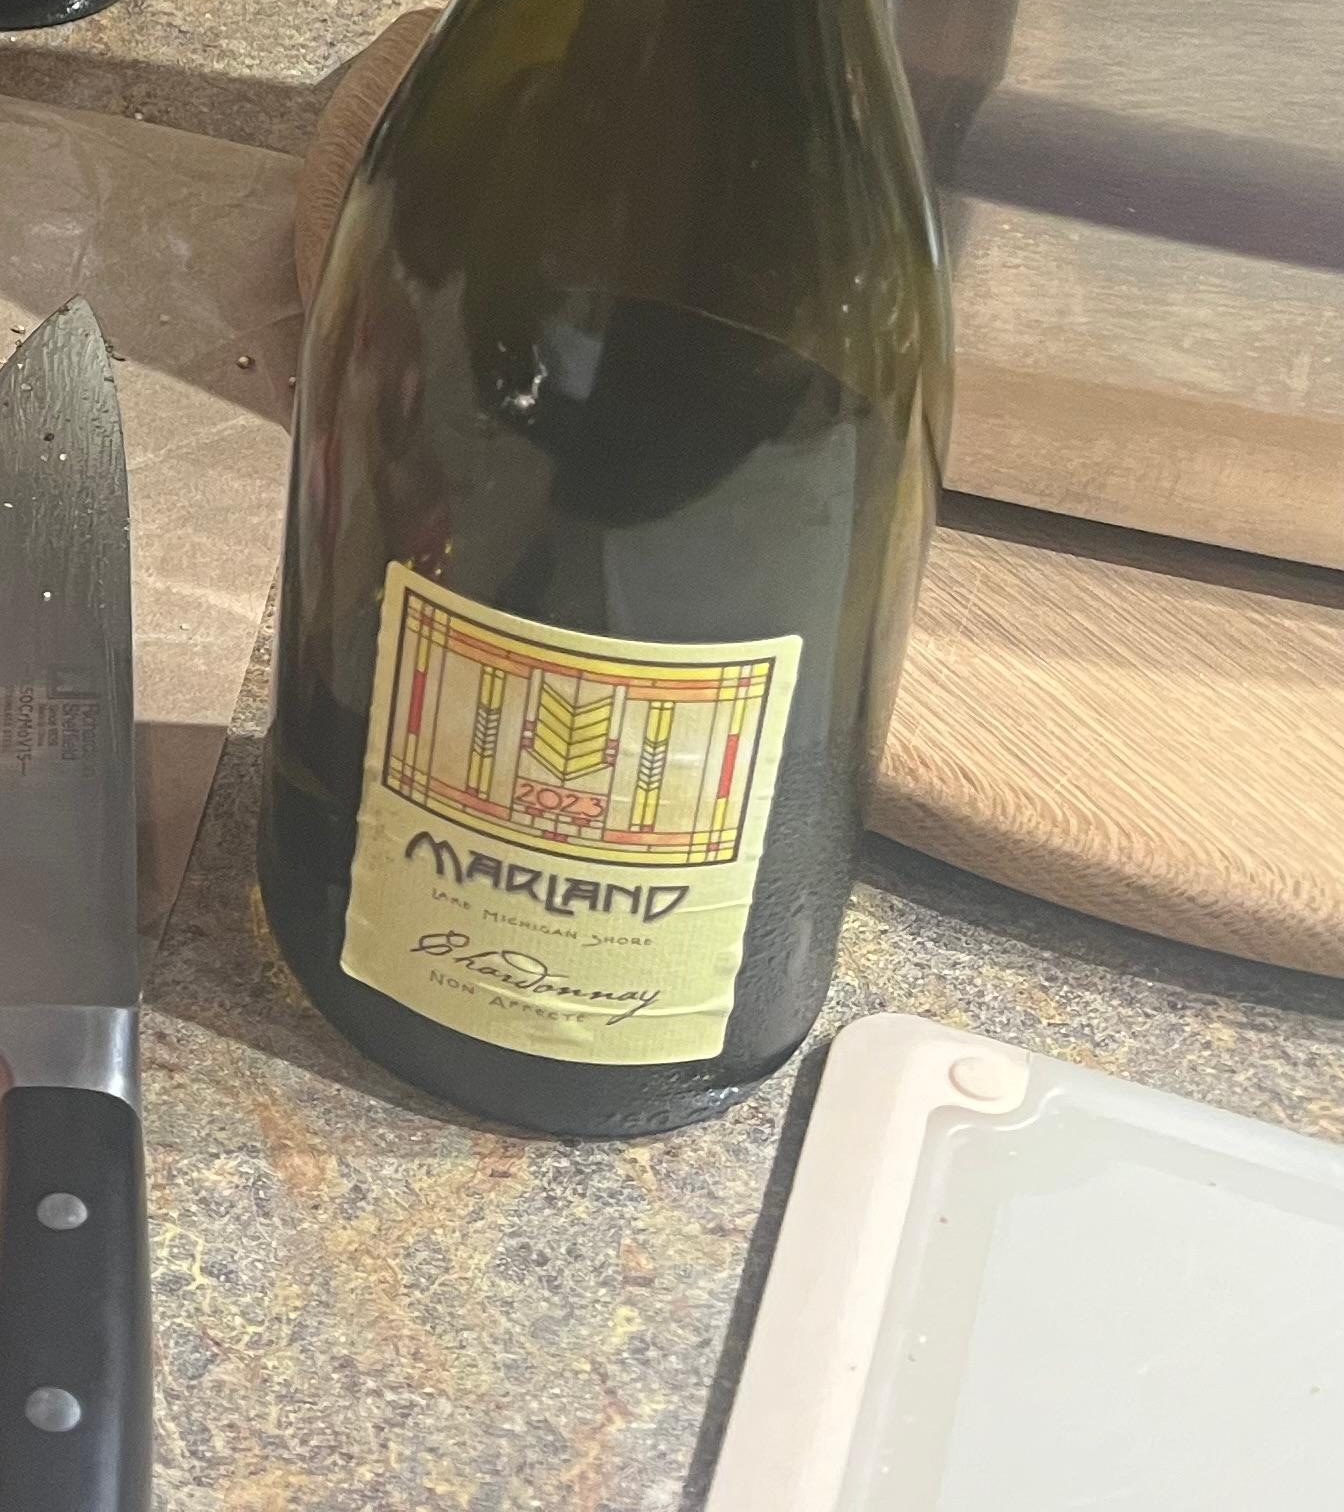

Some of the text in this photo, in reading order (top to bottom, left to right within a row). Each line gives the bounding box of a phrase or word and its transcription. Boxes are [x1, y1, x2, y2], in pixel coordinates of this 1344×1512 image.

[514, 783, 607, 818] 2023
[404, 830, 691, 922] MARLAND
[482, 909, 579, 939] MICHIGAN
[581, 932, 654, 947] SHORE
[409, 930, 662, 1026] Chardonnay
